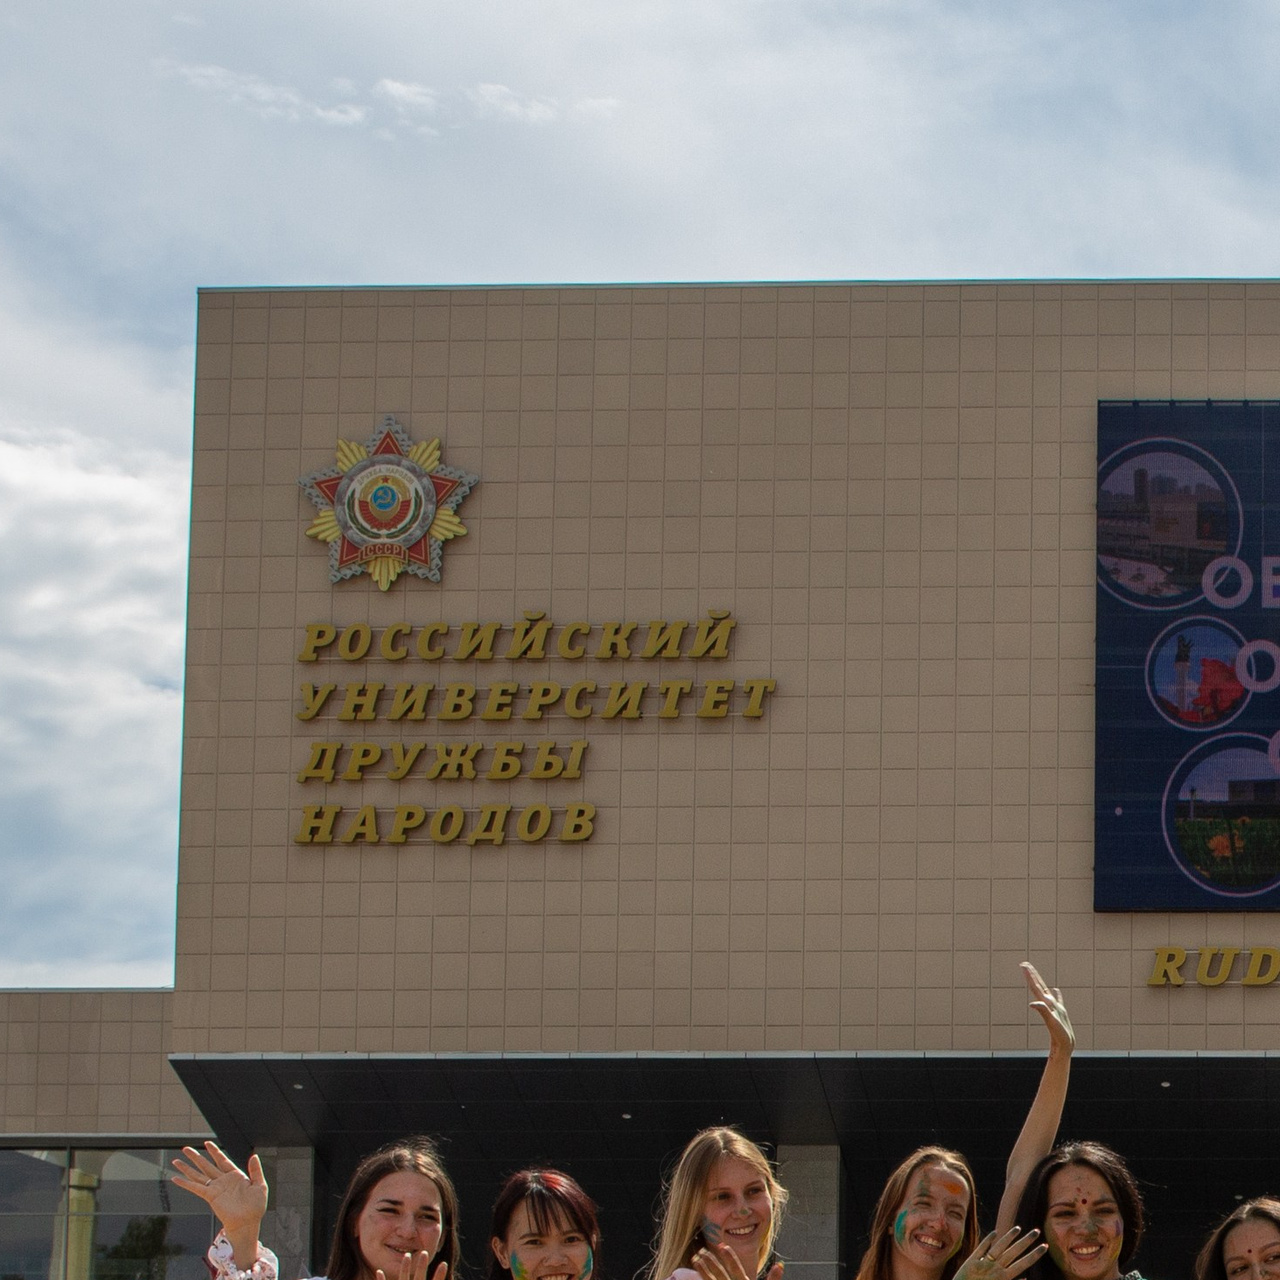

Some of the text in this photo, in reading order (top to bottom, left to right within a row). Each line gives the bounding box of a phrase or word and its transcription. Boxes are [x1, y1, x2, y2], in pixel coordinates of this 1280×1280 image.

[366, 543, 400, 555] СССР
[298, 610, 737, 662] РОССИЙСКИЙ
[296, 678, 776, 721] УНИВЕРСИТЕТ
[297, 740, 589, 783] ДРУЖБЫ
[294, 802, 596, 845] НАРОДОВ
